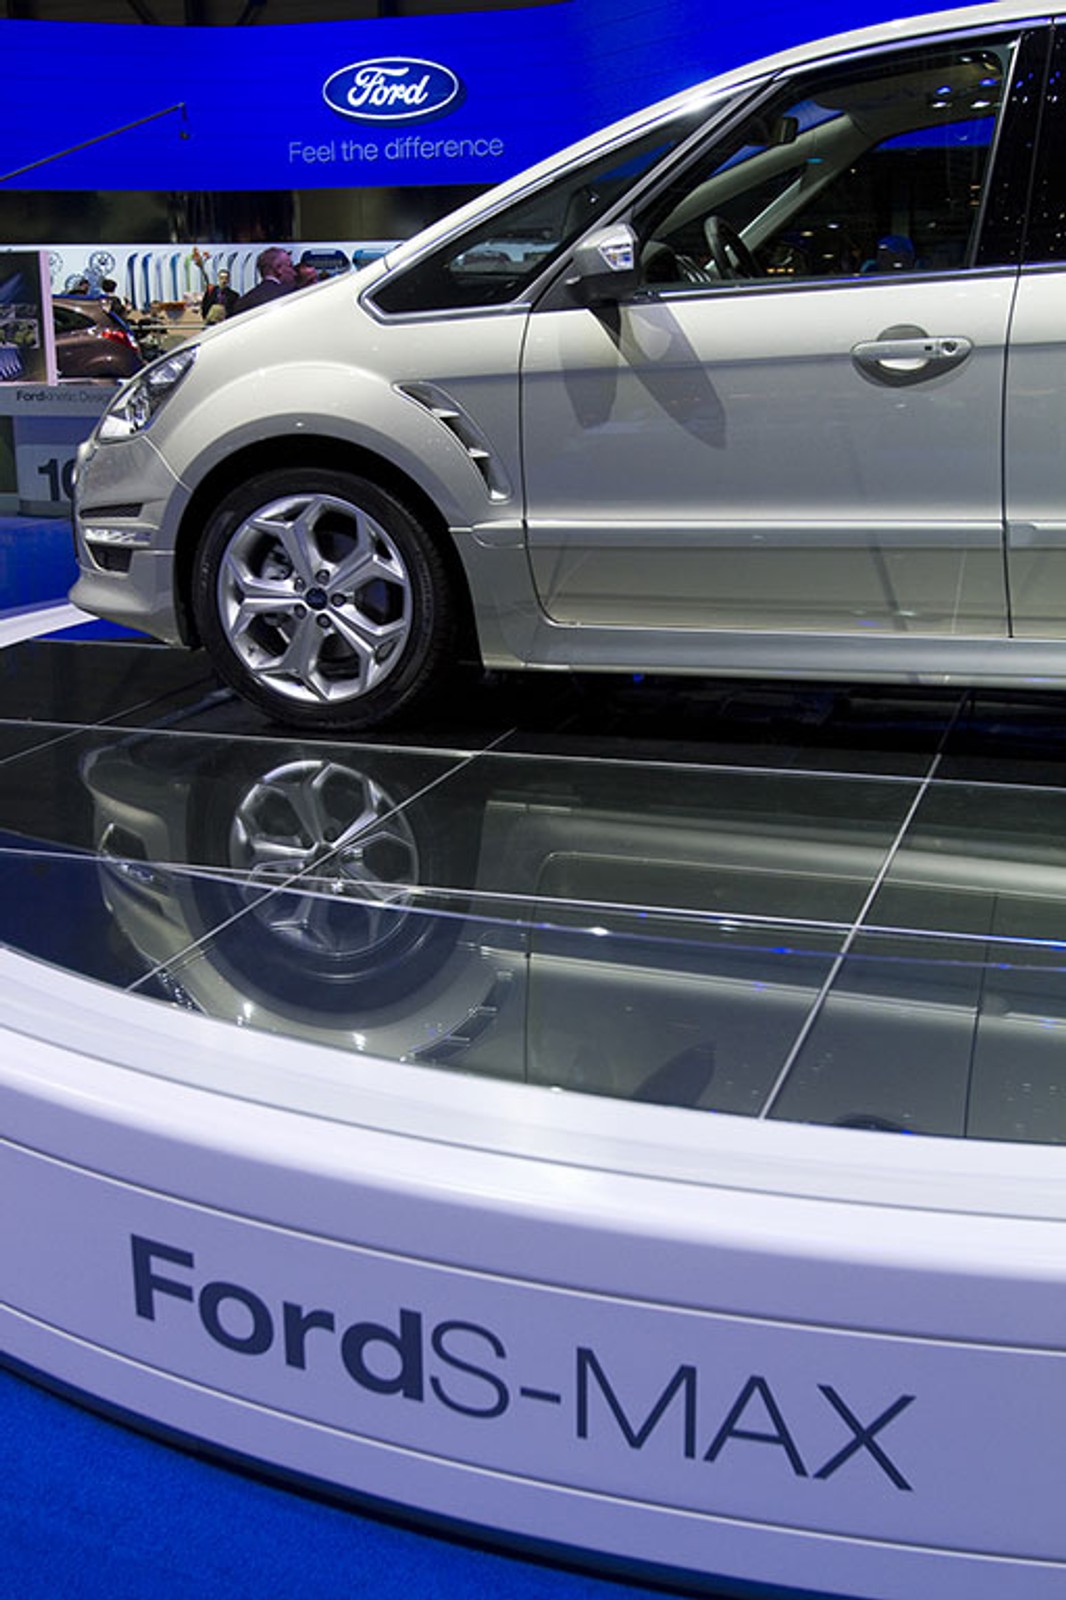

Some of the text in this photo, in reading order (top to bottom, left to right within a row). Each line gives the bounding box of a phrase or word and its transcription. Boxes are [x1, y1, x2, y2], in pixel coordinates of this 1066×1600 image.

[347, 67, 430, 107] Ford
[289, 136, 504, 163] Feel the difference
